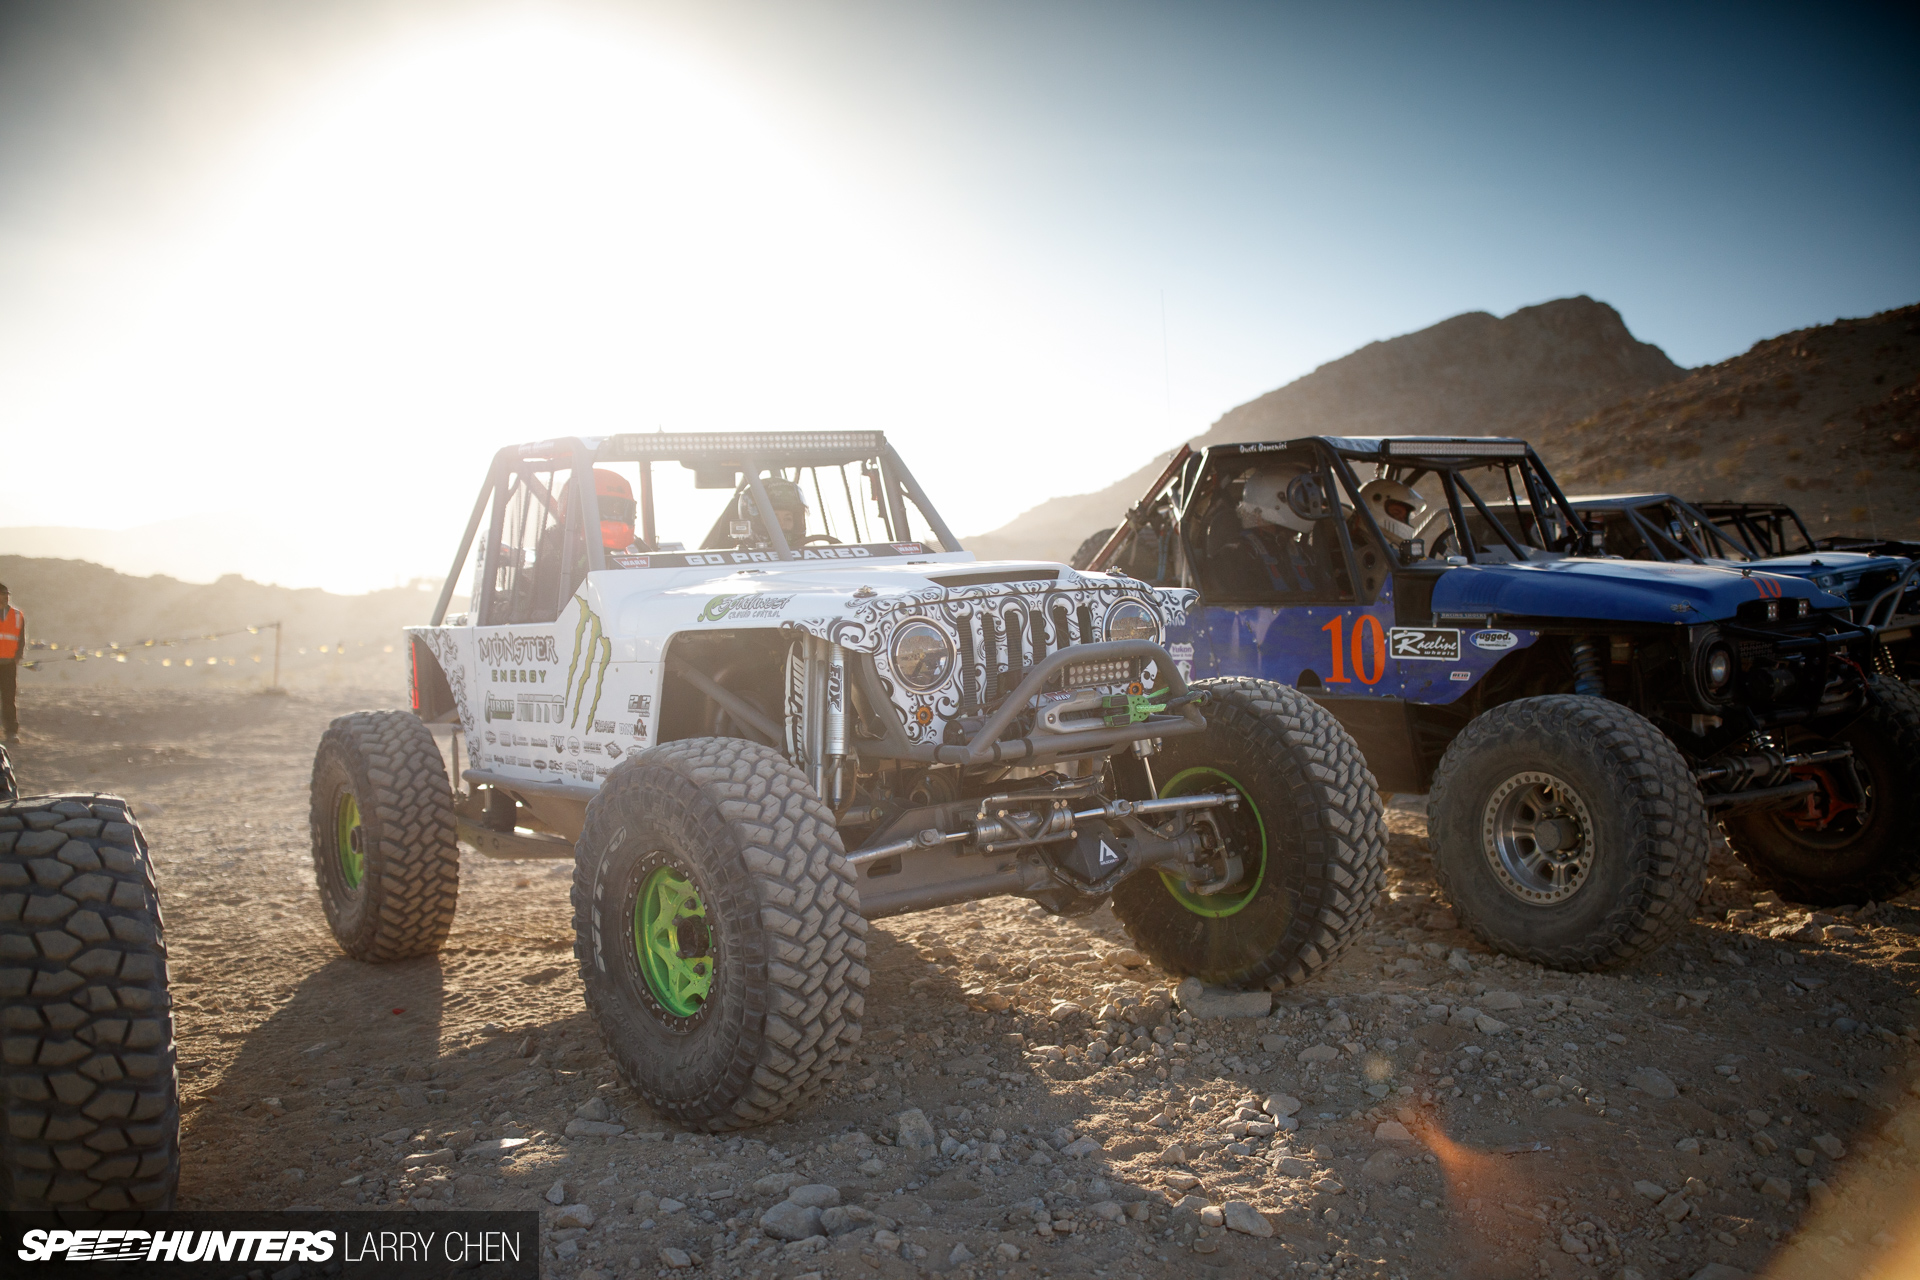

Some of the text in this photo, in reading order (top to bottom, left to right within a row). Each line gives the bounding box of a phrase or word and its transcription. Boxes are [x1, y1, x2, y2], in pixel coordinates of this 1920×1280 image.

[684, 554, 725, 565] GO
[896, 545, 922, 554] WARN
[619, 558, 649, 567] WARN
[1751, 577, 1782, 599] 10
[478, 631, 559, 667] MONSTER
[1321, 614, 1386, 685] 10
[1393, 632, 1457, 655] Raceline
[491, 669, 547, 683] ENERGY
[827, 662, 844, 713] FOX
[484, 690, 515, 724] CURRIE
[516, 693, 565, 724] NITTO
